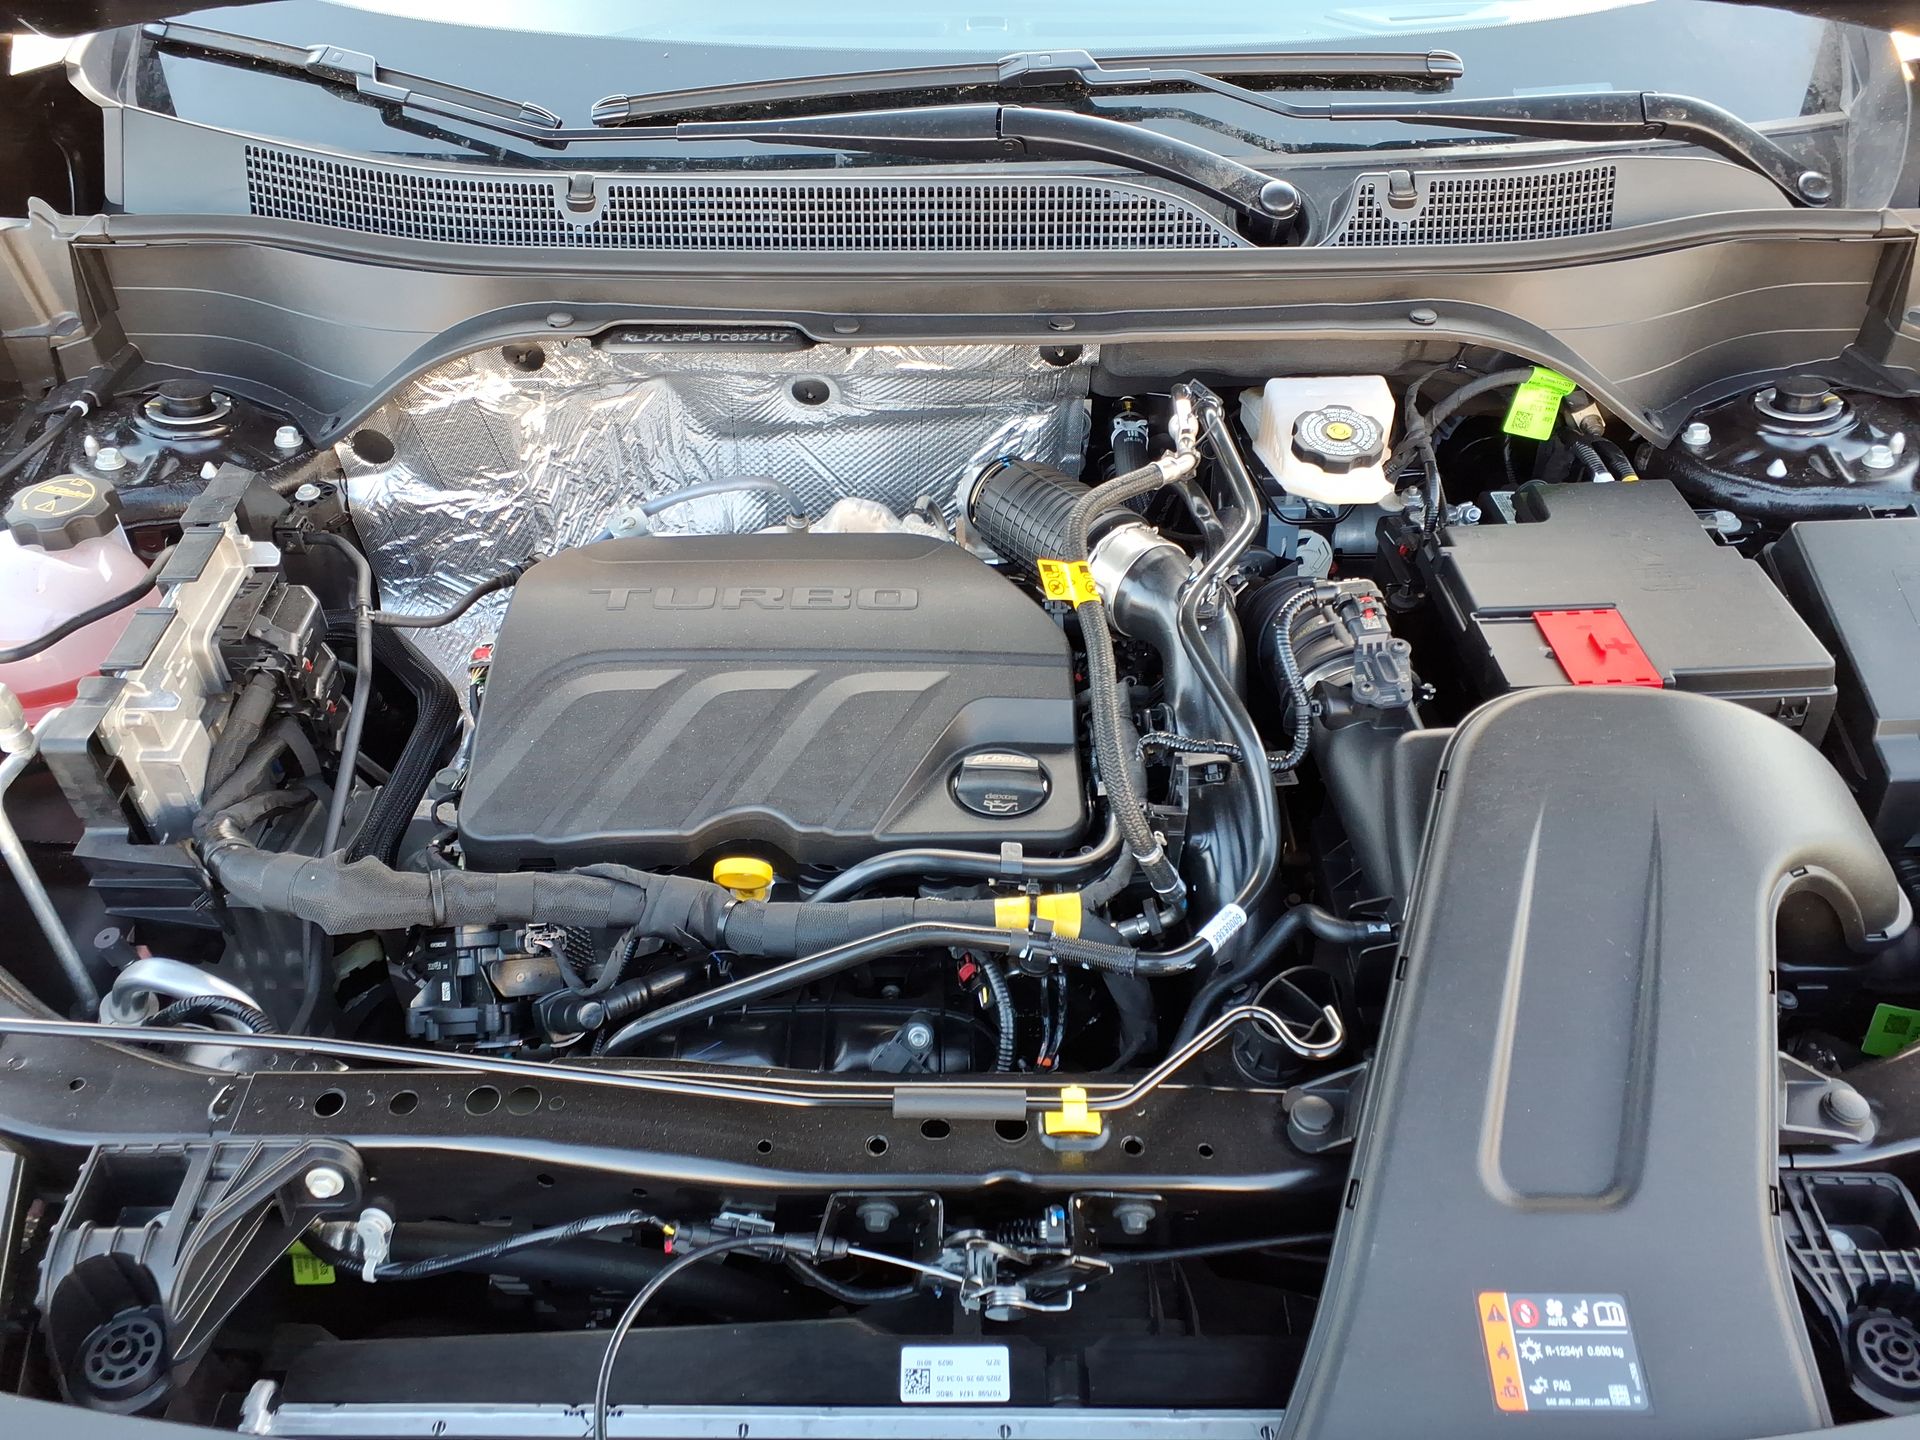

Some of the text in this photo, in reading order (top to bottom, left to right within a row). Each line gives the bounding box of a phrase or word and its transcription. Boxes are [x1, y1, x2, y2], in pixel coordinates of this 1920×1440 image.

[591, 587, 920, 611] TURBO
[1548, 1317, 1568, 1327] AUTO
[1612, 1346, 1625, 1359] kg
[1553, 1379, 1572, 1392] PAG
